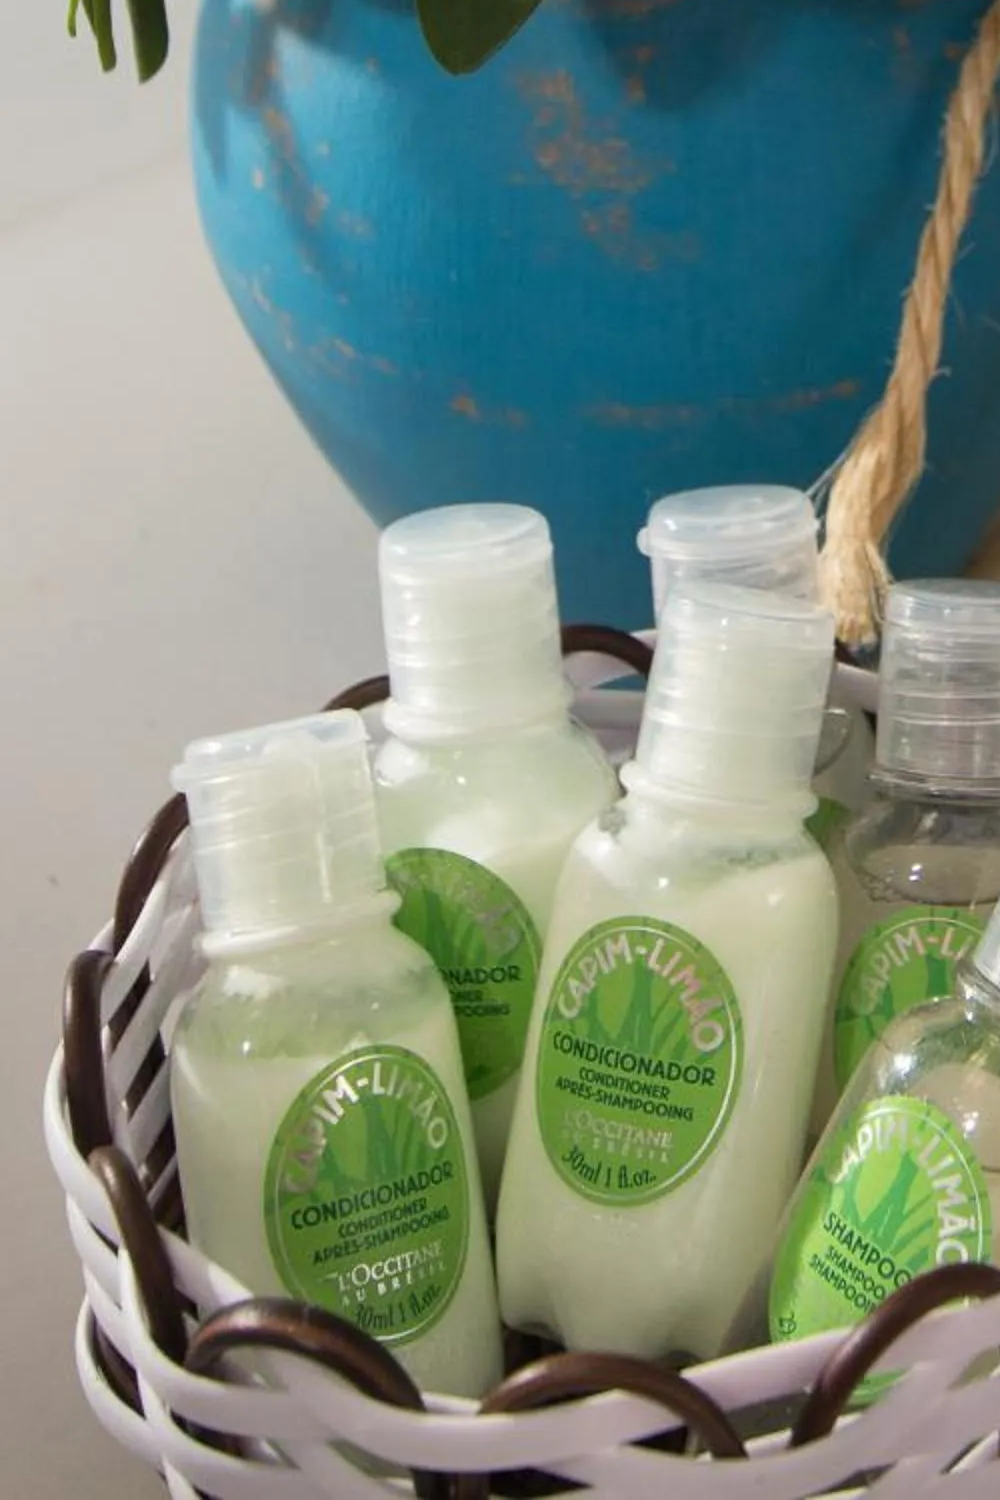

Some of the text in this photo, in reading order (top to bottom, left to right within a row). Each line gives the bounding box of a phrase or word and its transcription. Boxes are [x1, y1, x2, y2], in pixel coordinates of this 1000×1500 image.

[555, 931, 726, 1053] CAPIM-LIMÃO
[850, 925, 975, 1016] CAPIM-LI
[553, 1030, 717, 1087] CONDICIONADOR
[578, 1065, 671, 1102] CONDITIONER
[560, 1145, 603, 1186] 30ml
[832, 1114, 976, 1266] APIM-LIMÃO
[290, 1160, 455, 1231] CONDICIONADOR
[336, 1197, 428, 1239] CONDITIONER
[337, 1239, 443, 1292] L'OCCITANE
[822, 1211, 912, 1290] SHAMPOO
[824, 1245, 887, 1301] SHAMPOO
[808, 1253, 876, 1315] SHAMPOOI
[355, 1301, 395, 1331] 30ml
